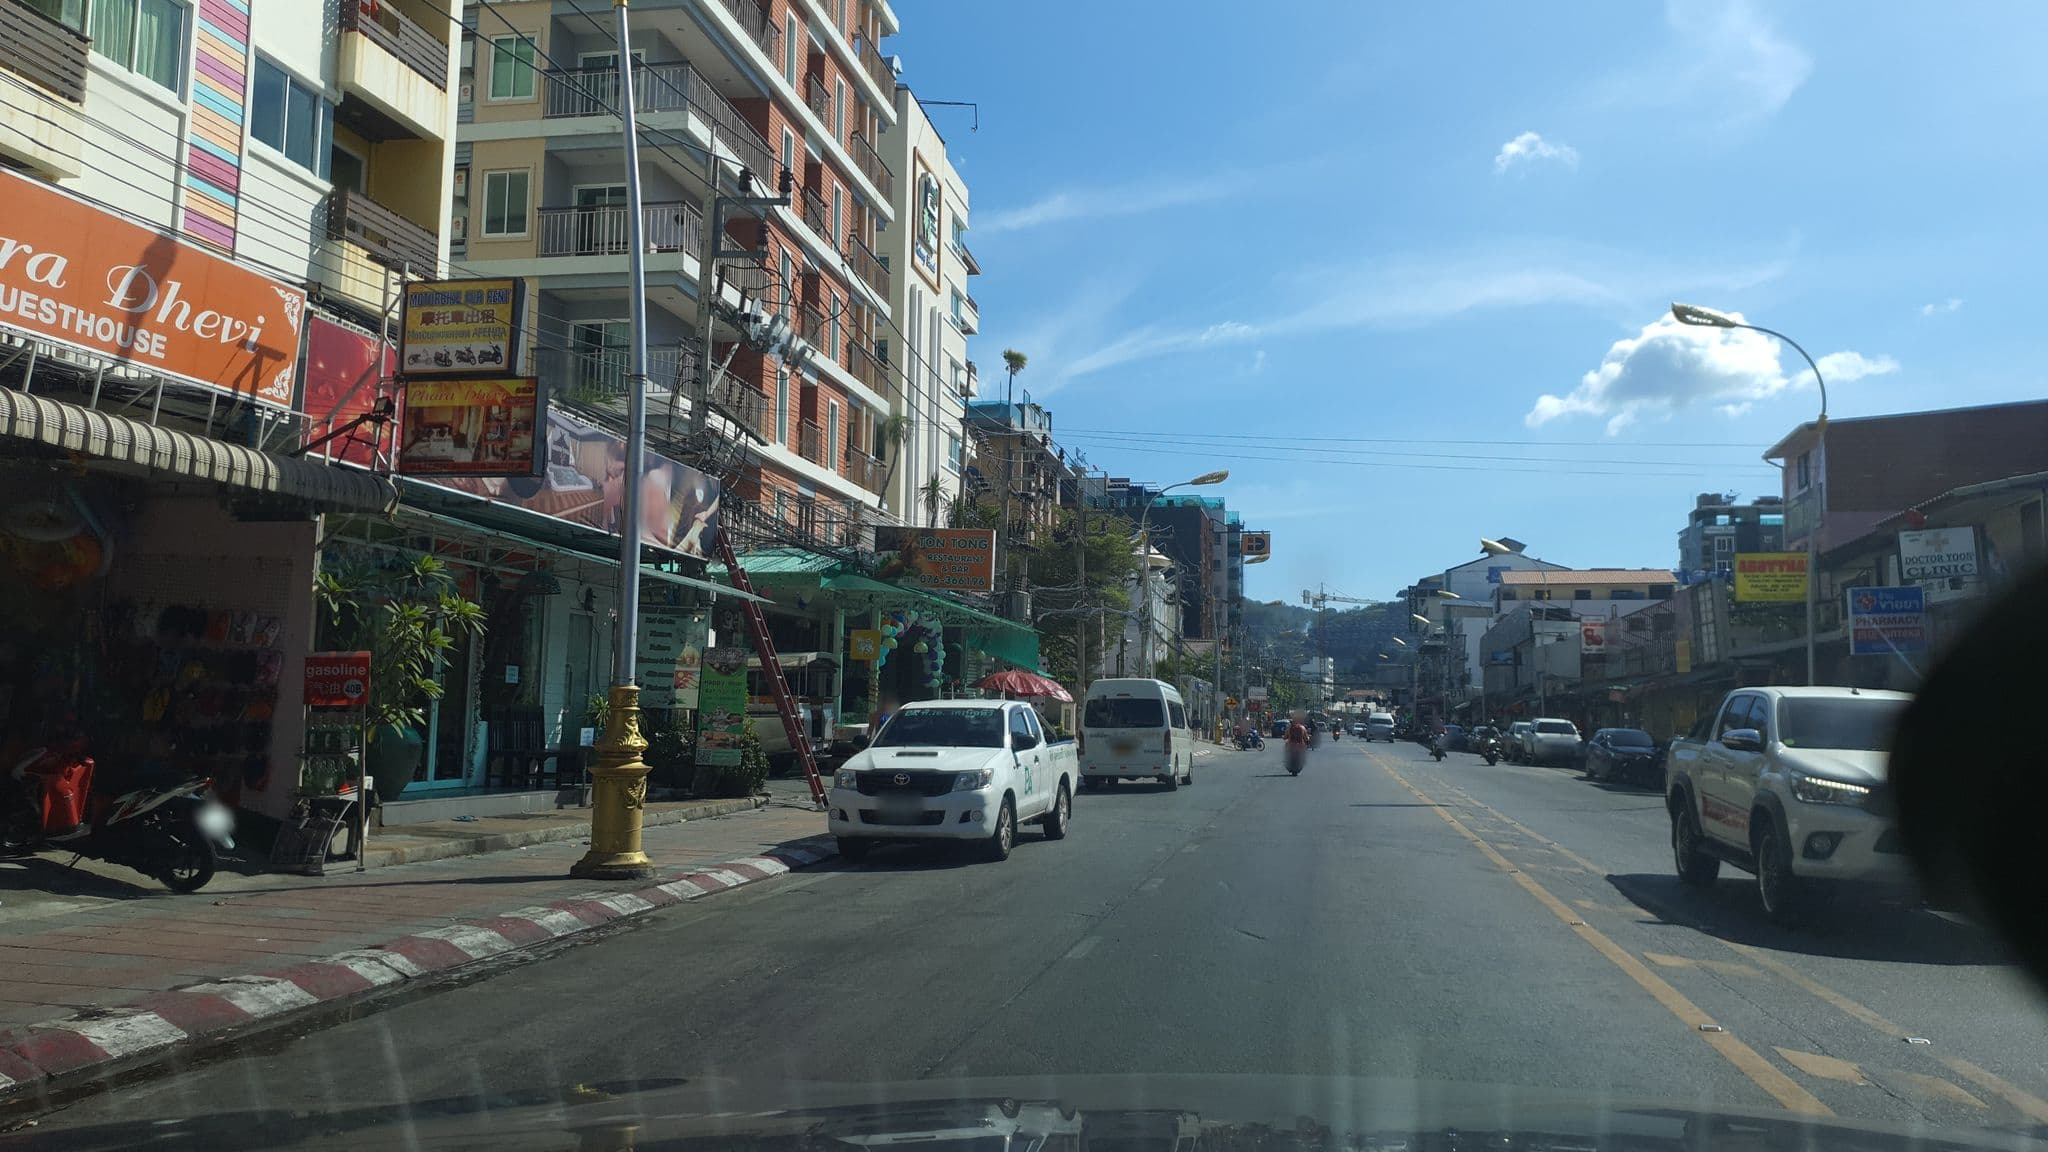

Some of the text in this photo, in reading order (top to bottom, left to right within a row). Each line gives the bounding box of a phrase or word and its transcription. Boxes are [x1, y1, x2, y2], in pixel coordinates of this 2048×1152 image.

[103, 264, 265, 354] Dhevi
[919, 537, 988, 549] TON TONG
[1905, 554, 1944, 565] DOCTOR
[1906, 563, 1975, 577] CLINIC
[1880, 599, 1920, 609] ขายยา
[1855, 615, 1920, 625] PHARMACY
[306, 663, 367, 678] gasoline
